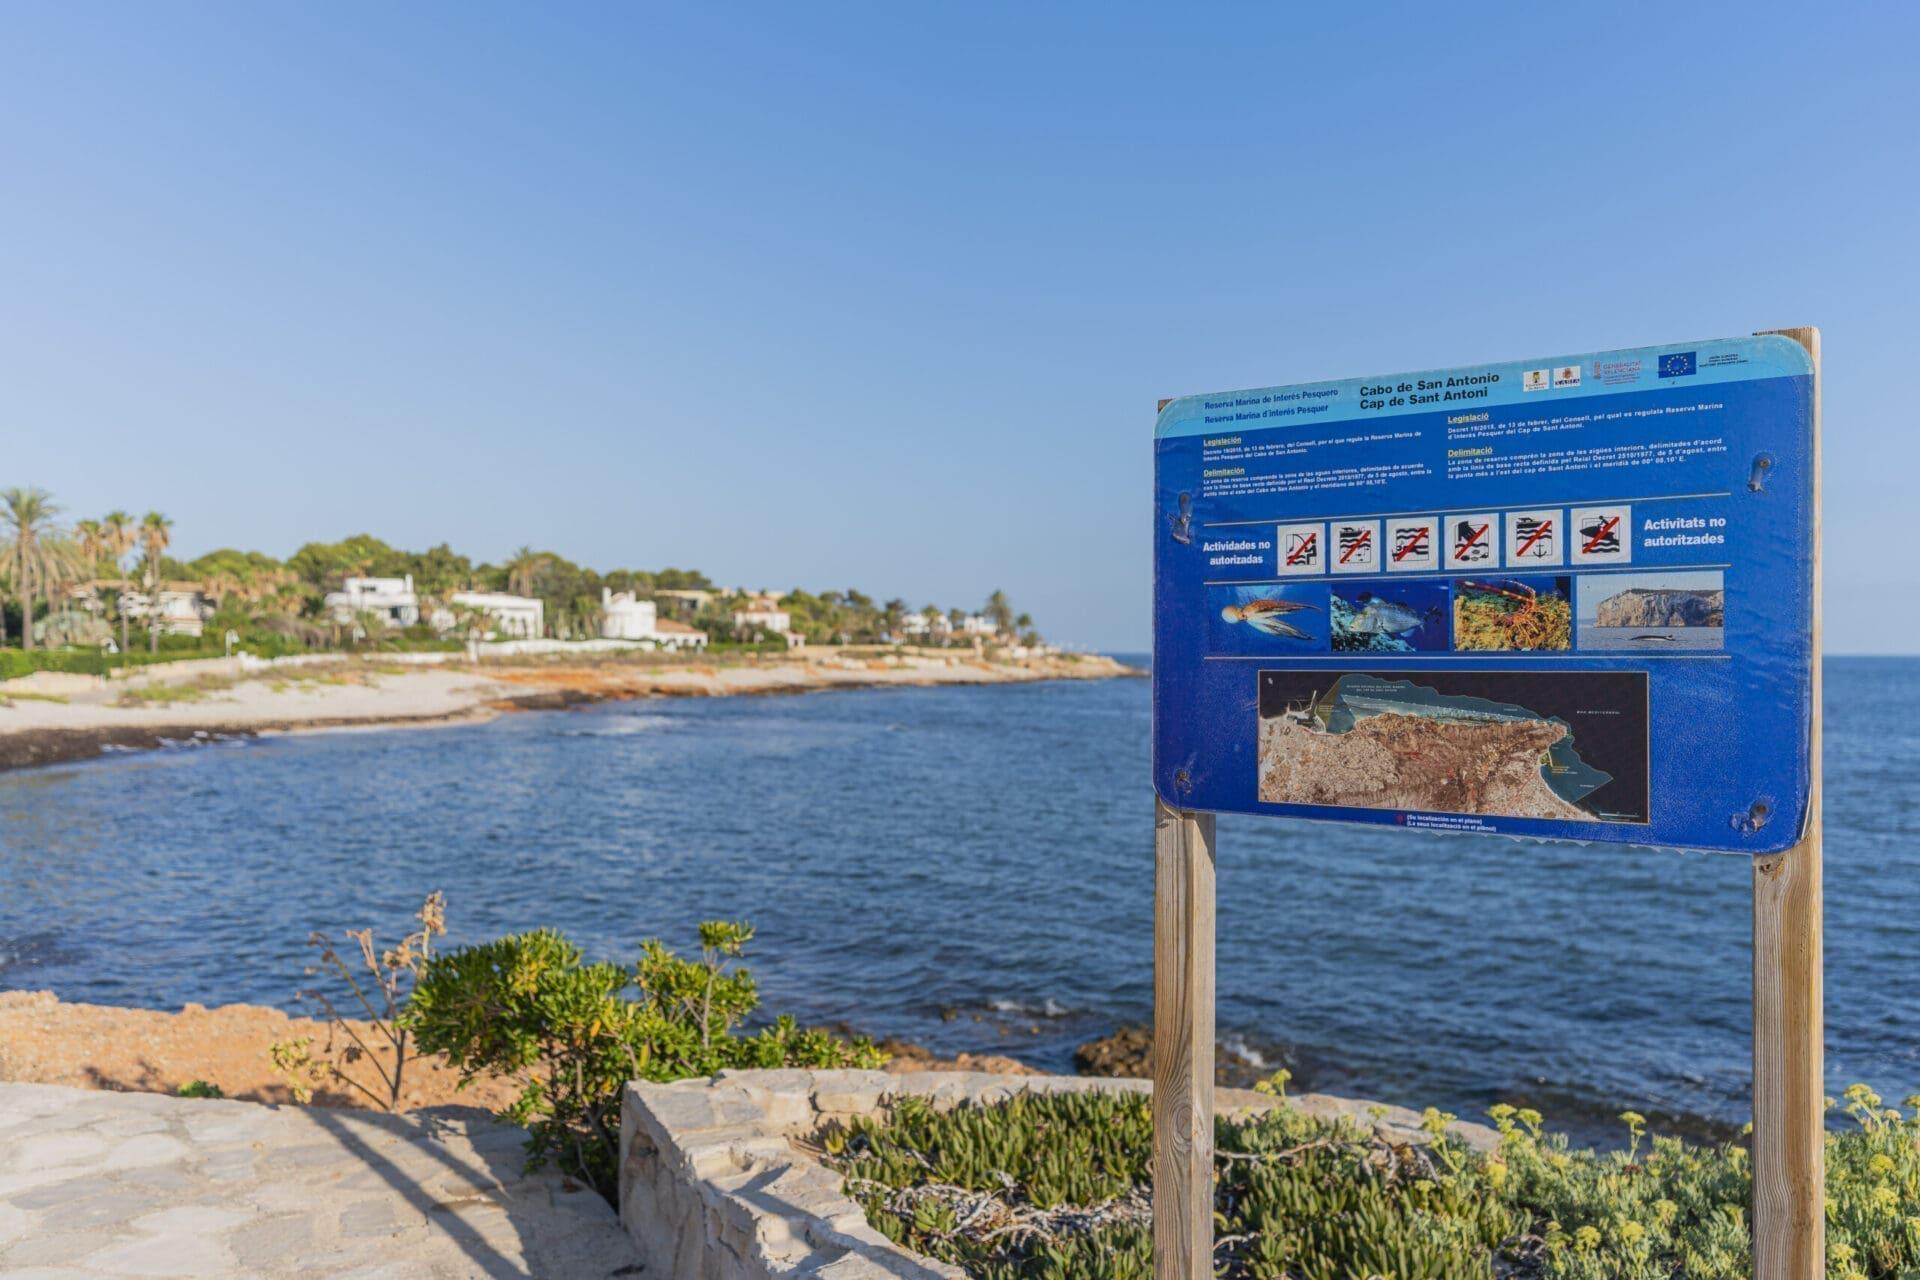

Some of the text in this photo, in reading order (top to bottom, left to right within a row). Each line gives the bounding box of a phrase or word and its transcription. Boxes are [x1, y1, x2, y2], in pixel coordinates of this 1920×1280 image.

[1360, 373, 1500, 396] Cabo de San Antonio
[1204, 389, 1338, 409] Reserva Marina de Interés Pesquero
[1360, 387, 1488, 410] Cap de Sant Antoni
[1204, 415, 1233, 424] Reserva
[1236, 411, 1260, 420] Marina
[1298, 405, 1328, 415] Pesquer
[1448, 413, 1489, 424] Legislació
[1448, 426, 1468, 434] Decret
[1594, 413, 1604, 422] pel
[1606, 412, 1622, 420] qual
[1666, 406, 1695, 414] Reserva
[1698, 403, 1723, 411] Marina
[1560, 422, 1584, 430] Antoni.
[1203, 437, 1242, 447] Legislación
[1649, 441, 1691, 449] delimitades
[1448, 446, 1492, 457] Delimitació
[1532, 458, 1558, 466] definida
[1593, 453, 1616, 461] Decret
[1203, 468, 1245, 478] Delimitación
[1456, 471, 1473, 479] punta
[1565, 462, 1588, 470] Antoni
[1644, 518, 1726, 530] Activitats no
[1644, 533, 1724, 547] autoritzades
[1202, 541, 1270, 552] Actividades no
[1210, 555, 1263, 566] autorizadas
[1465, 817, 1482, 825] plano)
